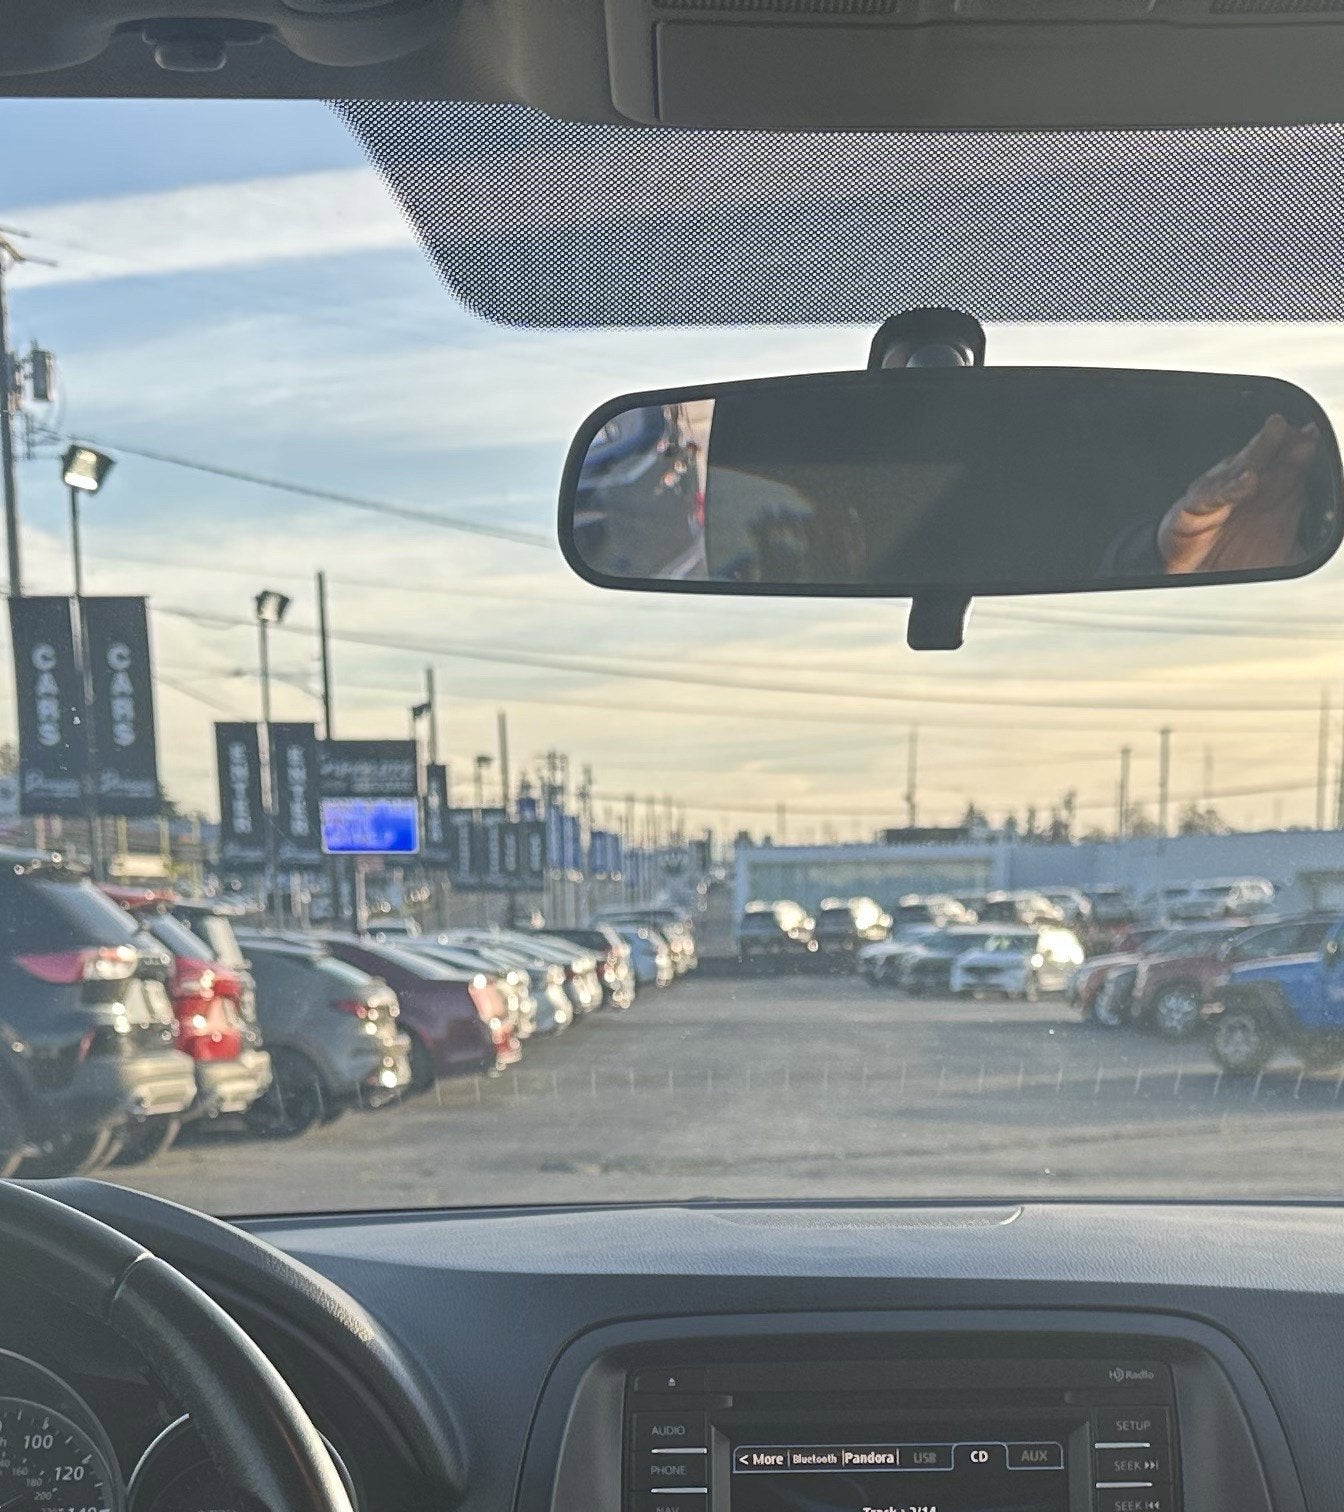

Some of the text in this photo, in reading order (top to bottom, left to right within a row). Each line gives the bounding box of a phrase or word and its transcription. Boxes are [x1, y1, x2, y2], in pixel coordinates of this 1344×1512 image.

[650, 1424, 686, 1436] AUDIO
[1114, 1419, 1151, 1432] SETUP
[23, 1434, 55, 1450] 100
[751, 1448, 1048, 1466] More Bluetooth Pandora USB CD AUX
[649, 1465, 688, 1477] PHONE
[1113, 1459, 1142, 1471] SEEK
[54, 1466, 85, 1482] 120
[26, 1478, 43, 1487] 180
[33, 1491, 53, 1501] 200
[1114, 1500, 1143, 1512] SEEK
